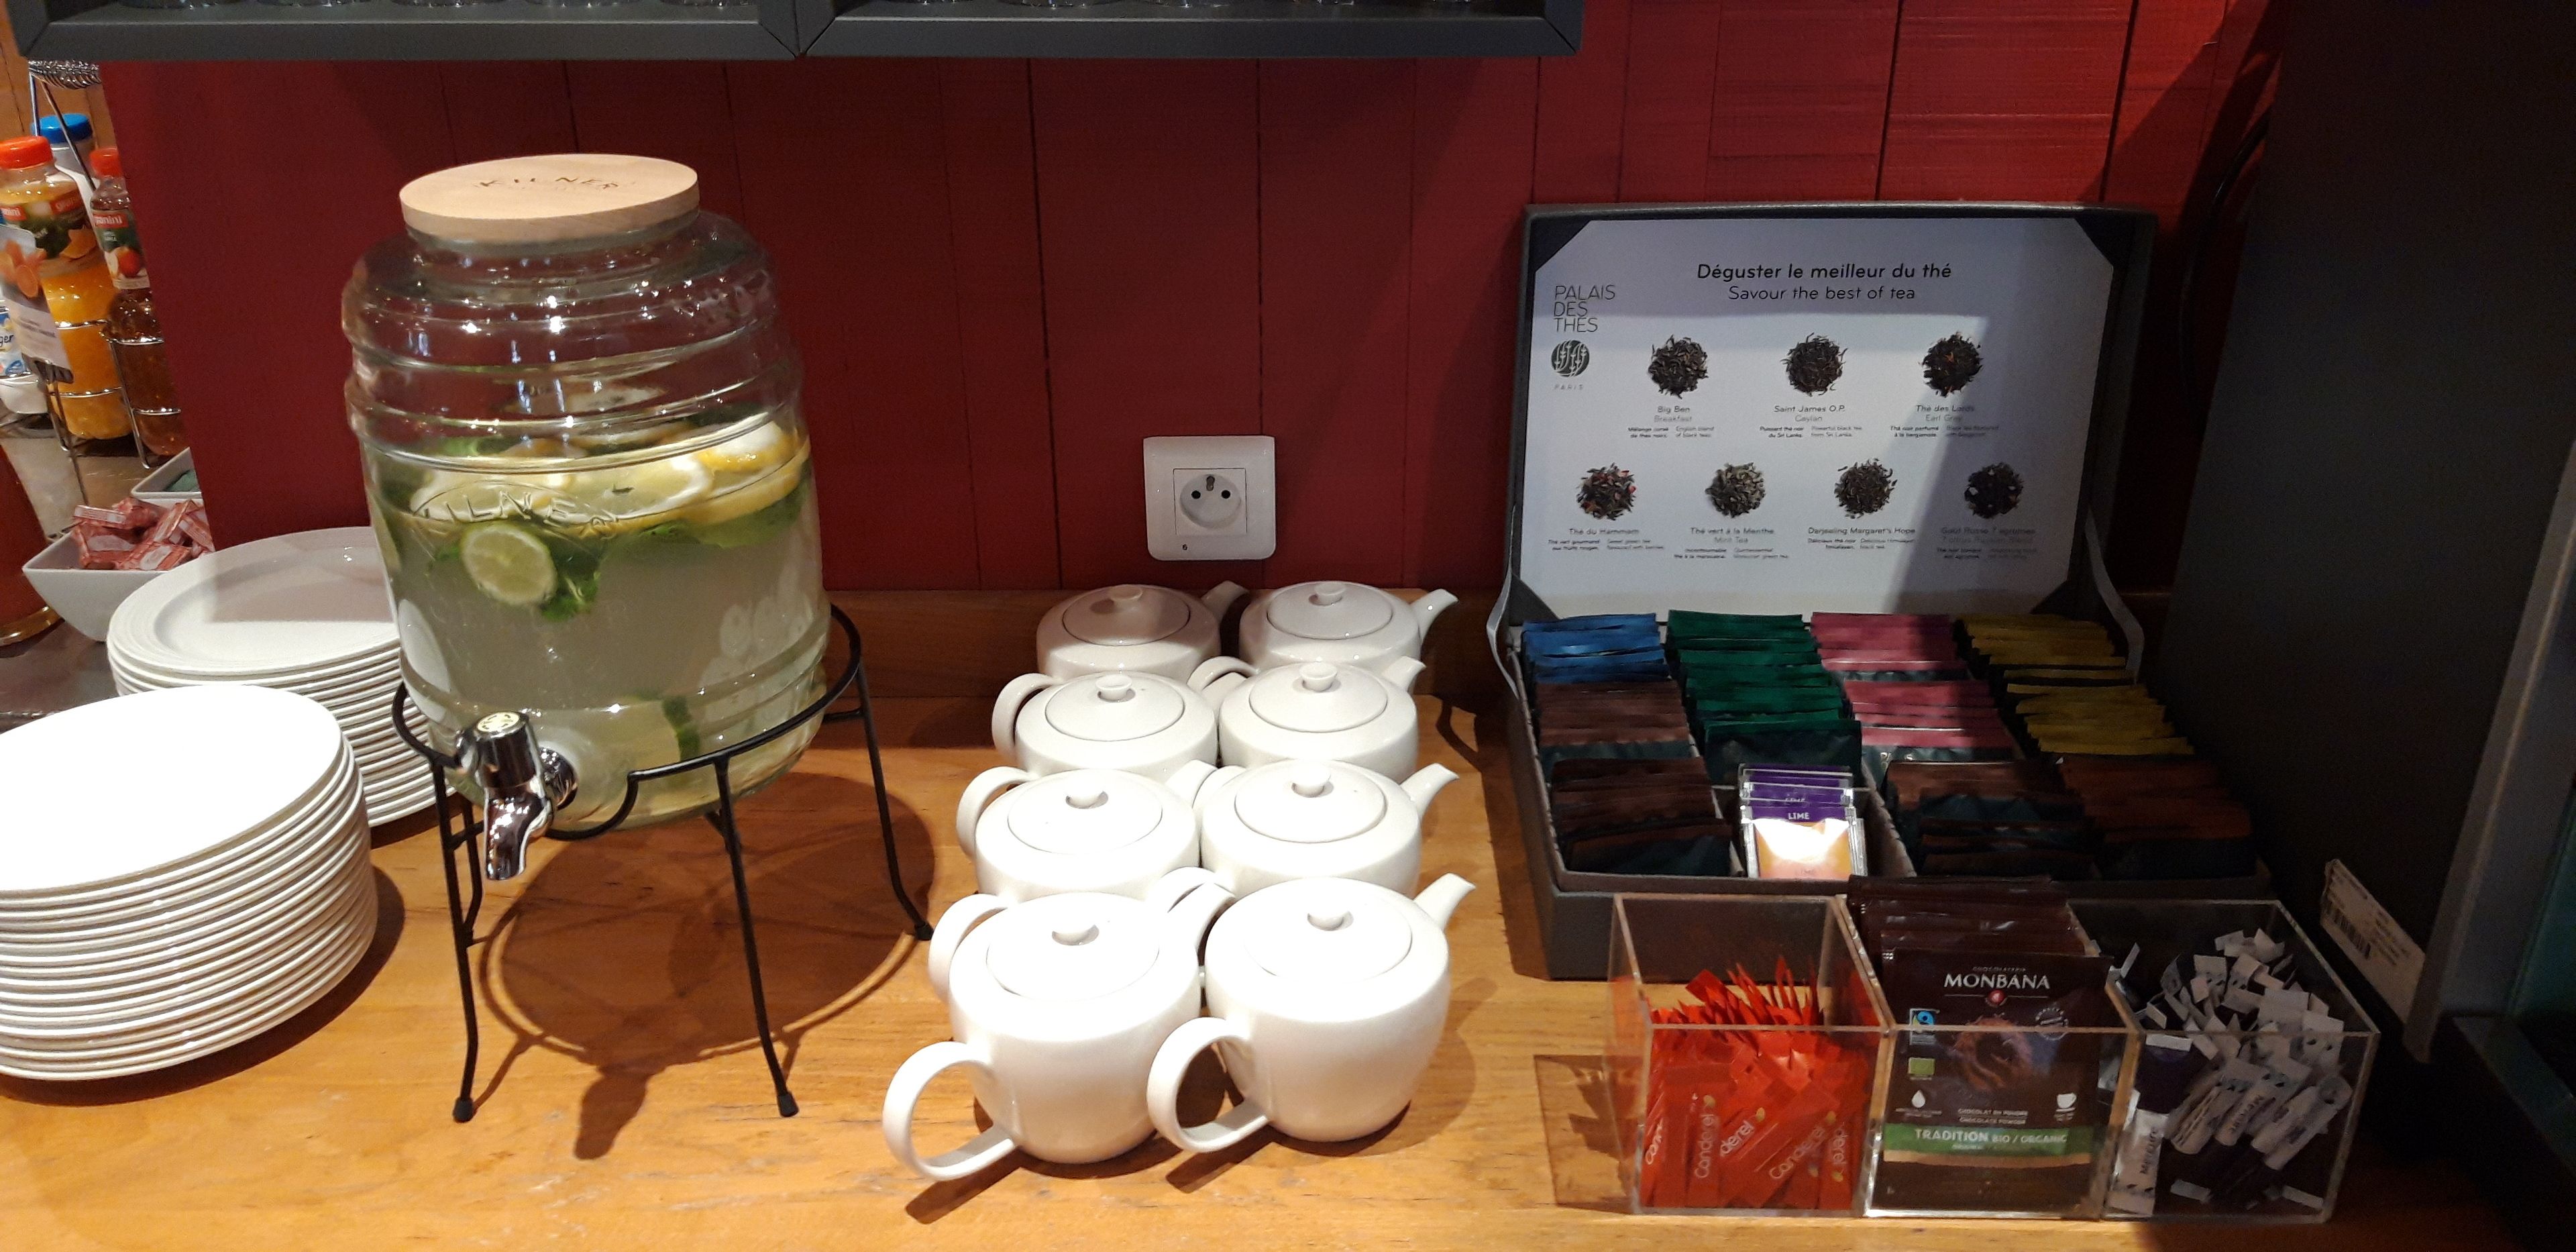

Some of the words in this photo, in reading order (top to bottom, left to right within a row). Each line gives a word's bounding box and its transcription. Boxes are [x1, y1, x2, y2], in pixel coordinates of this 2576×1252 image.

[1698, 264, 1781, 282] Déguster
[1788, 263, 1803, 278] le
[1811, 263, 1885, 278] meilleur
[1892, 263, 1915, 278] du
[1923, 263, 1951, 278] thé
[1555, 284, 1615, 300] PALAIS
[1728, 286, 1786, 299] Savour
[1793, 286, 1819, 299] the
[1826, 286, 1861, 299] best
[1867, 286, 1884, 299] of
[1890, 287, 1915, 299] tea
[1554, 301, 1588, 317] DES
[1658, 406, 1670, 414] Big
[1944, 974, 2050, 989] MONBANA
[1915, 1129, 1988, 1142] TRADITION
